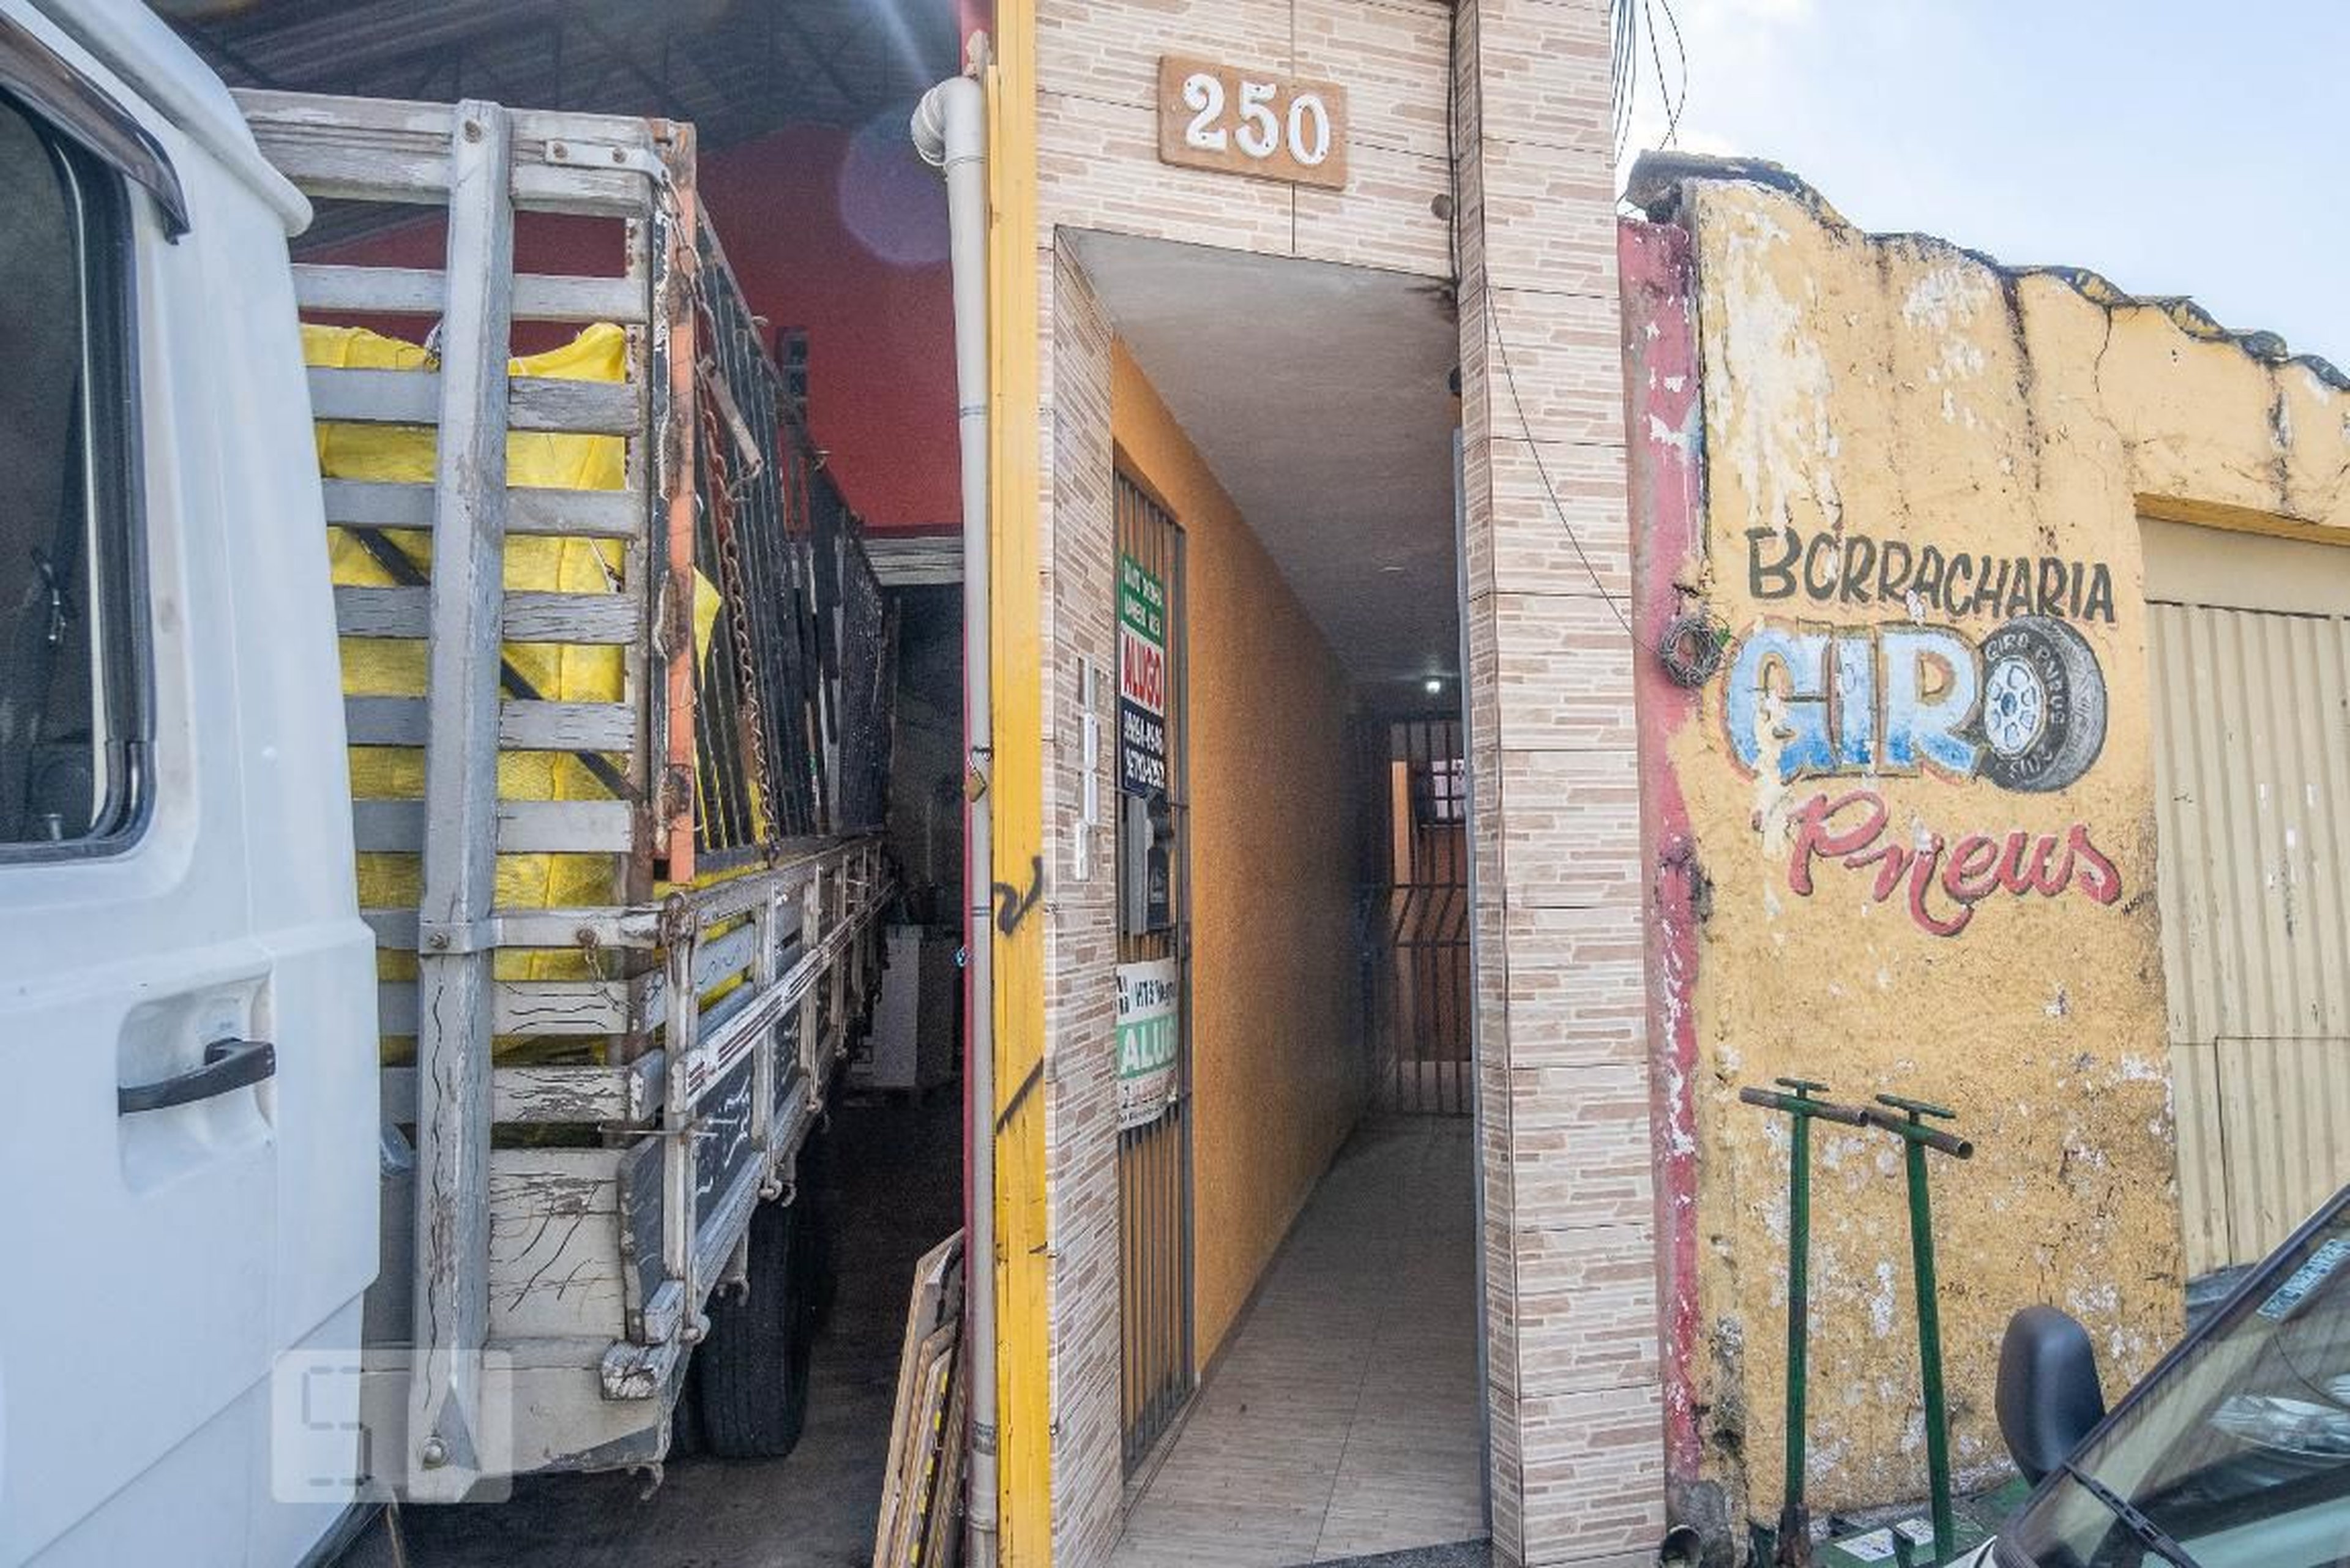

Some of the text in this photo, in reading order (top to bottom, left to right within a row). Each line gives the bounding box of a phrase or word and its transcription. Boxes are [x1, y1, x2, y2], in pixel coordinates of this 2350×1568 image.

[1182, 73, 1330, 164] 250
[1745, 526, 2117, 624] BORRACHARIA
[1785, 791, 2122, 936] Pneus
